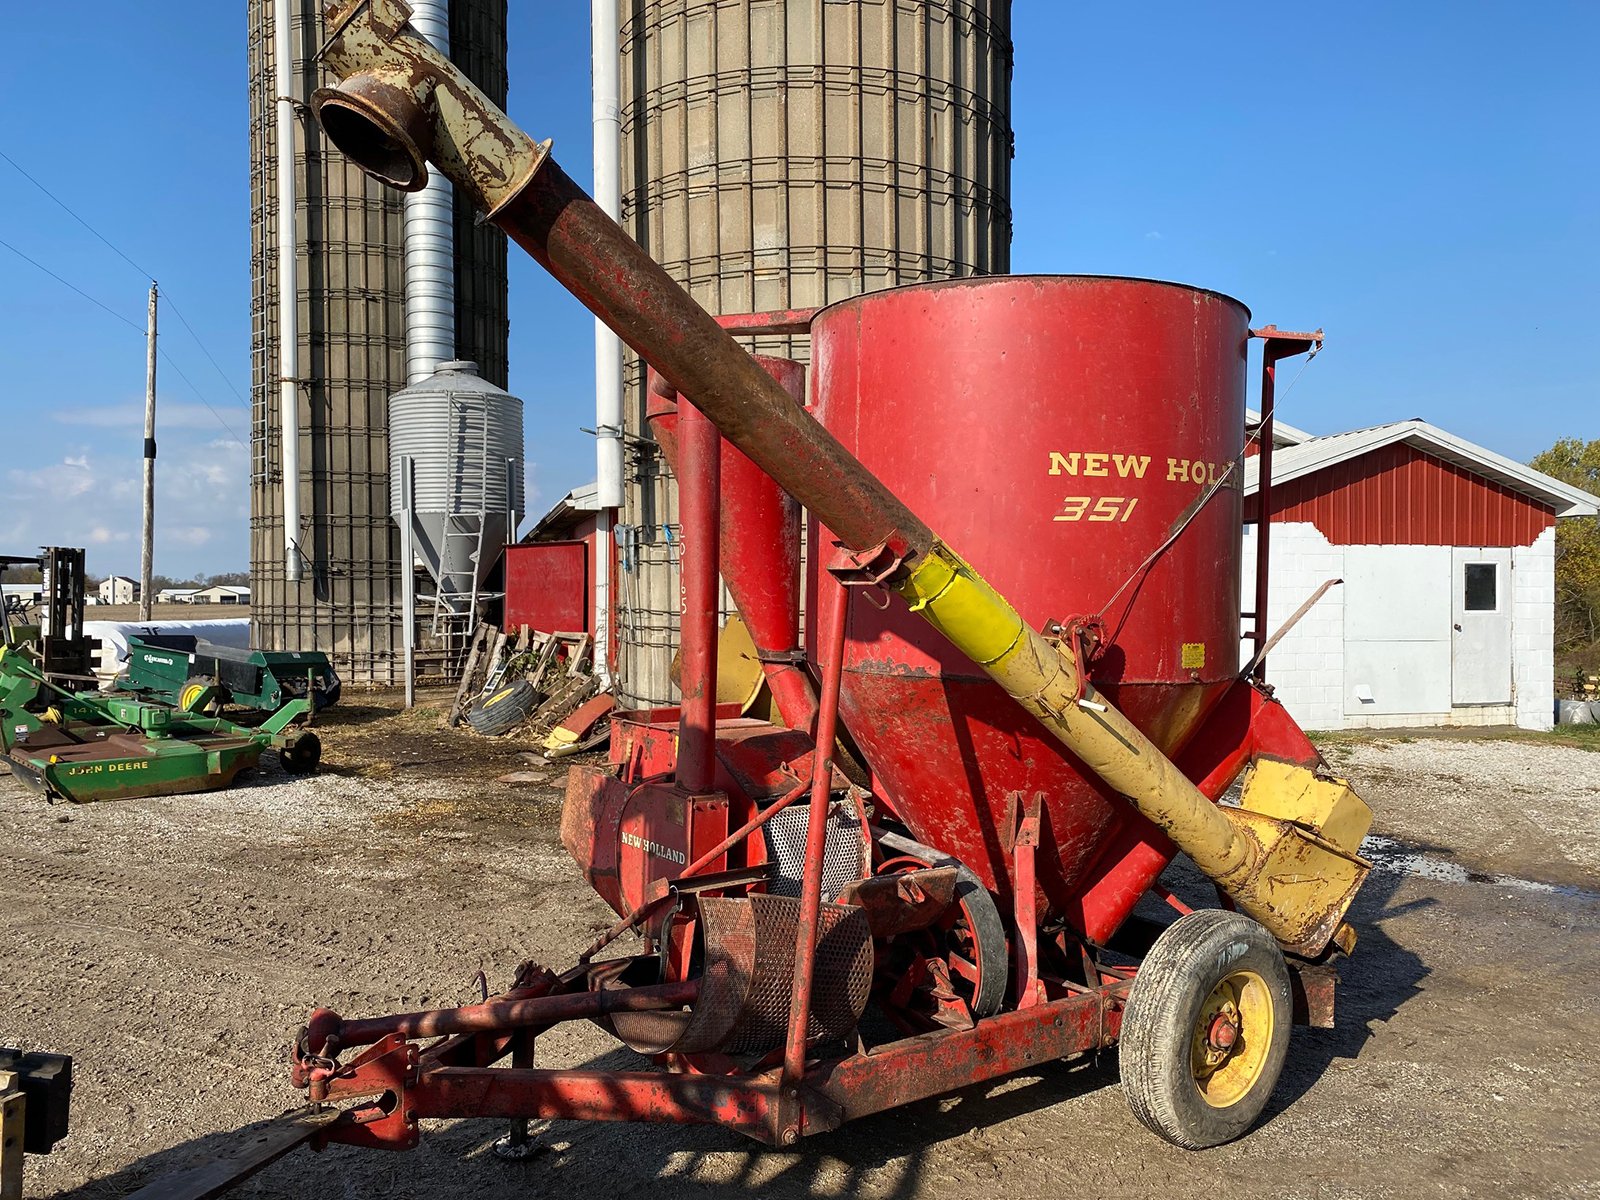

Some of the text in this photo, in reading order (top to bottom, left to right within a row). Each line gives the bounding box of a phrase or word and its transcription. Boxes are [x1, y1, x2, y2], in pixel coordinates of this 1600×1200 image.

[1049, 452, 1151, 479] NEW
[1053, 496, 1139, 522] 351
[108, 761, 149, 772] DEERE
[621, 831, 686, 865] NEW HOLLAND
